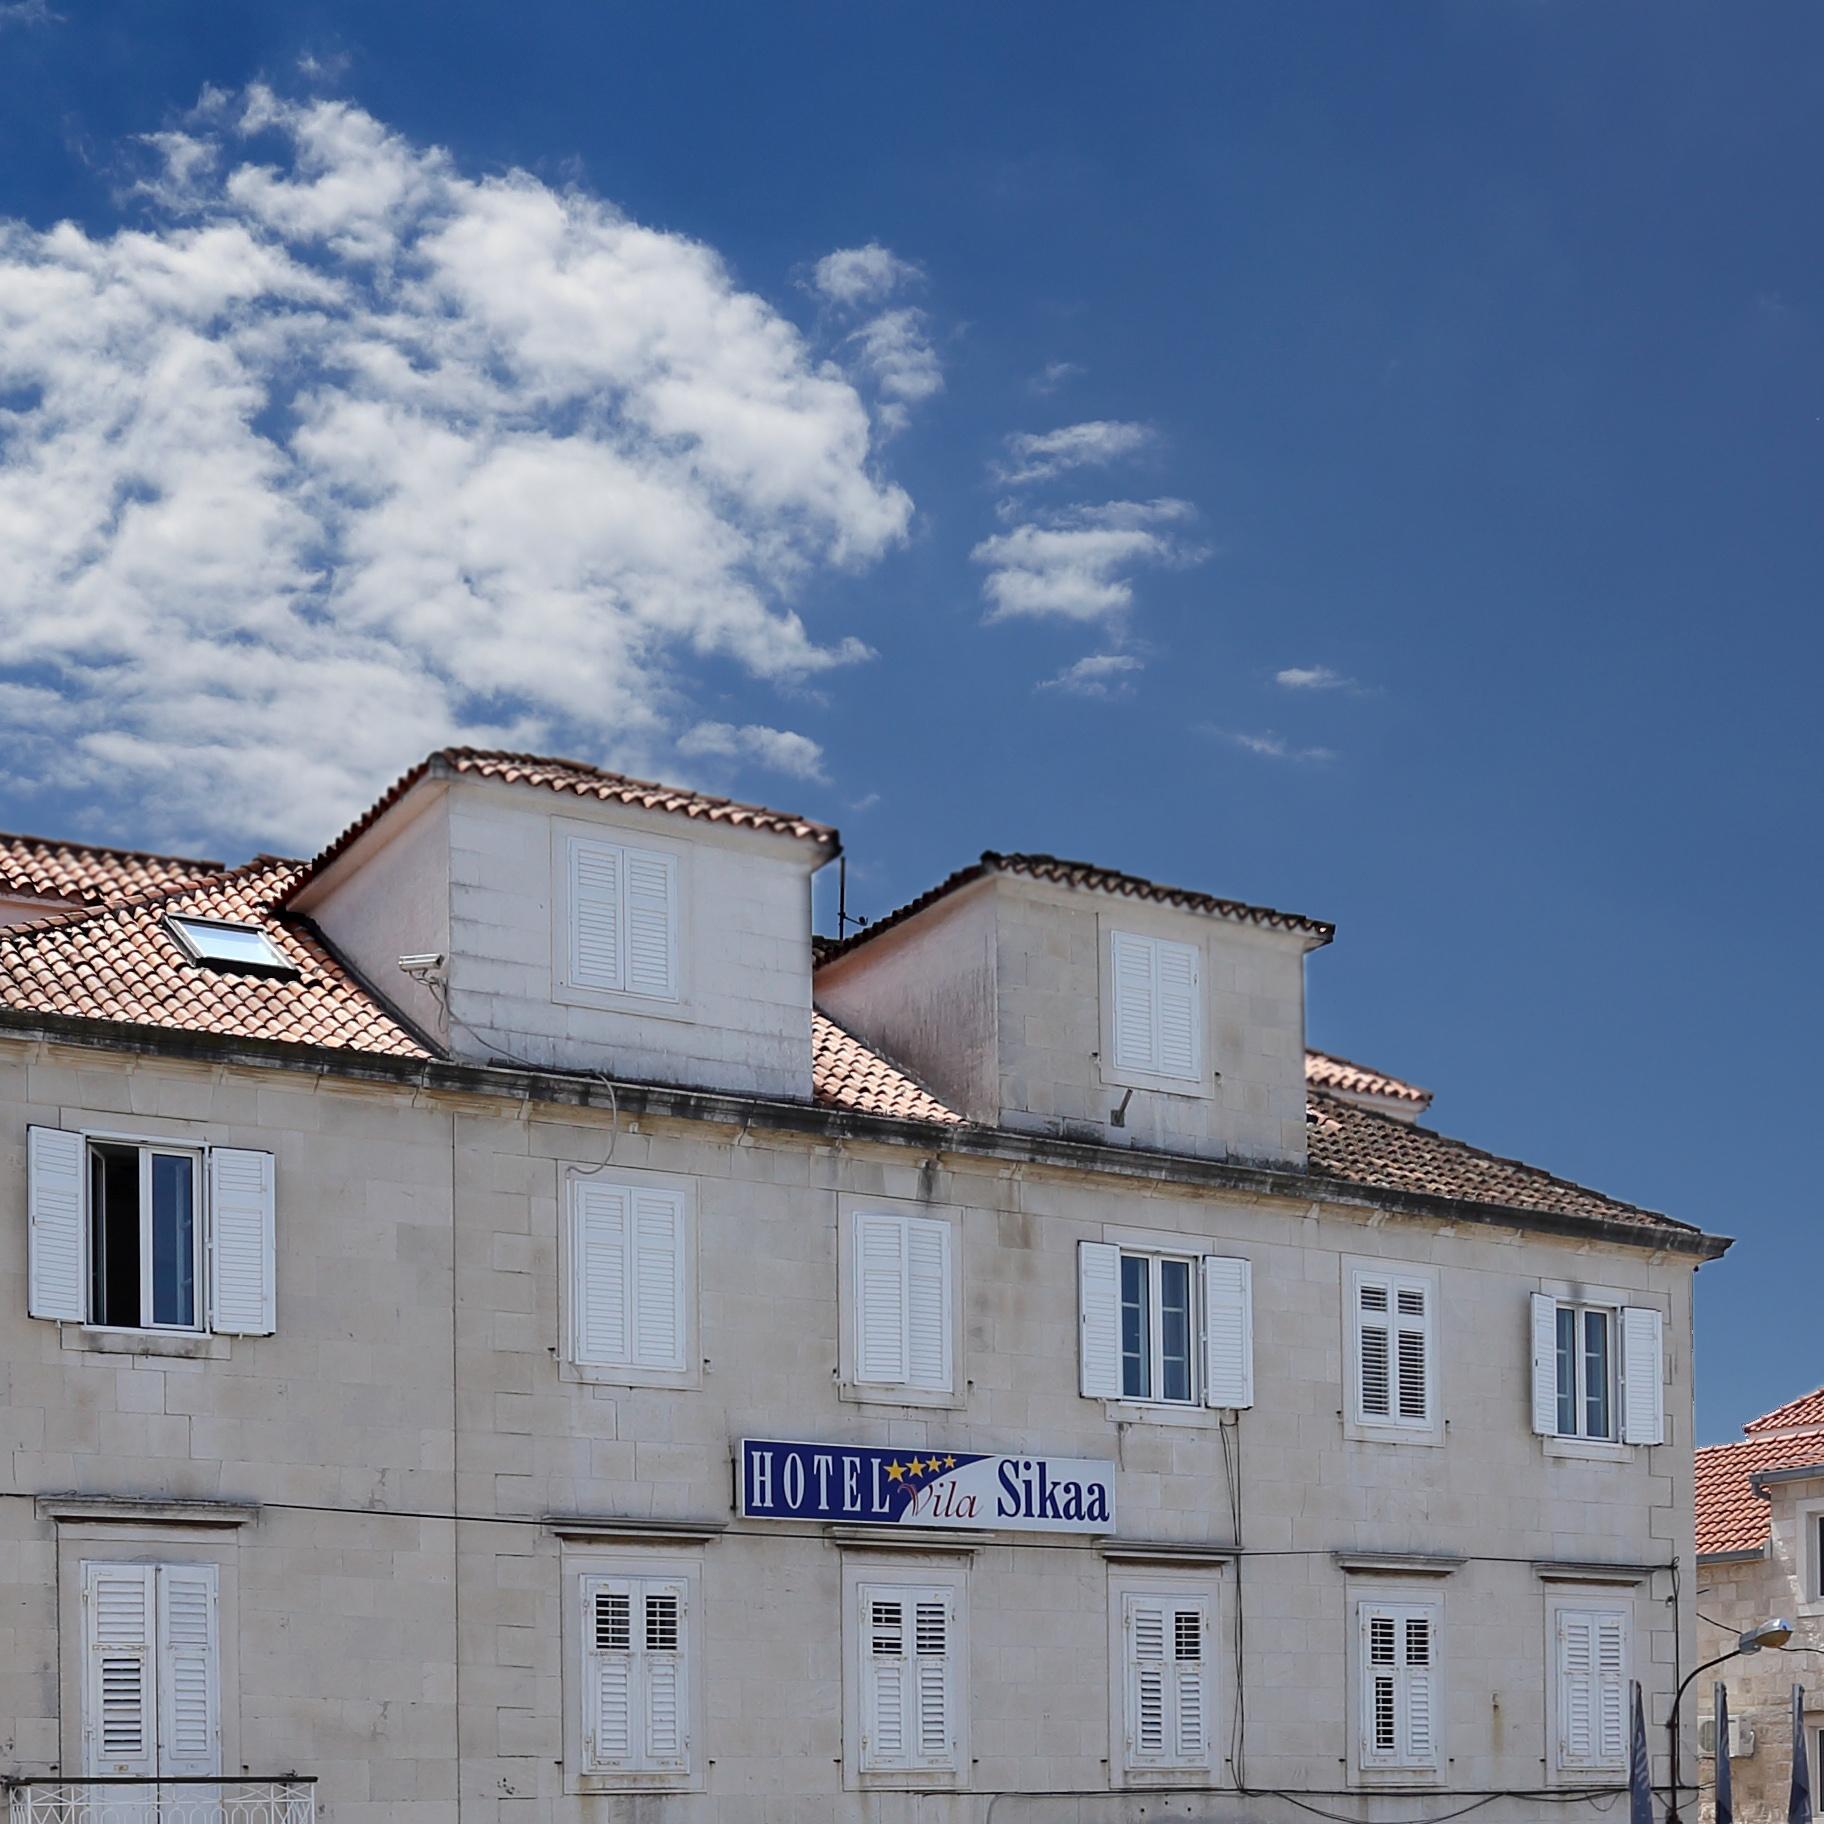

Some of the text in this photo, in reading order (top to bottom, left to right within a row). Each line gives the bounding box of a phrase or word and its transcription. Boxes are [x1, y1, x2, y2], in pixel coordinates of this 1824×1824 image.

[751, 1451, 1111, 1522] HOTEL Vila Sikaa
